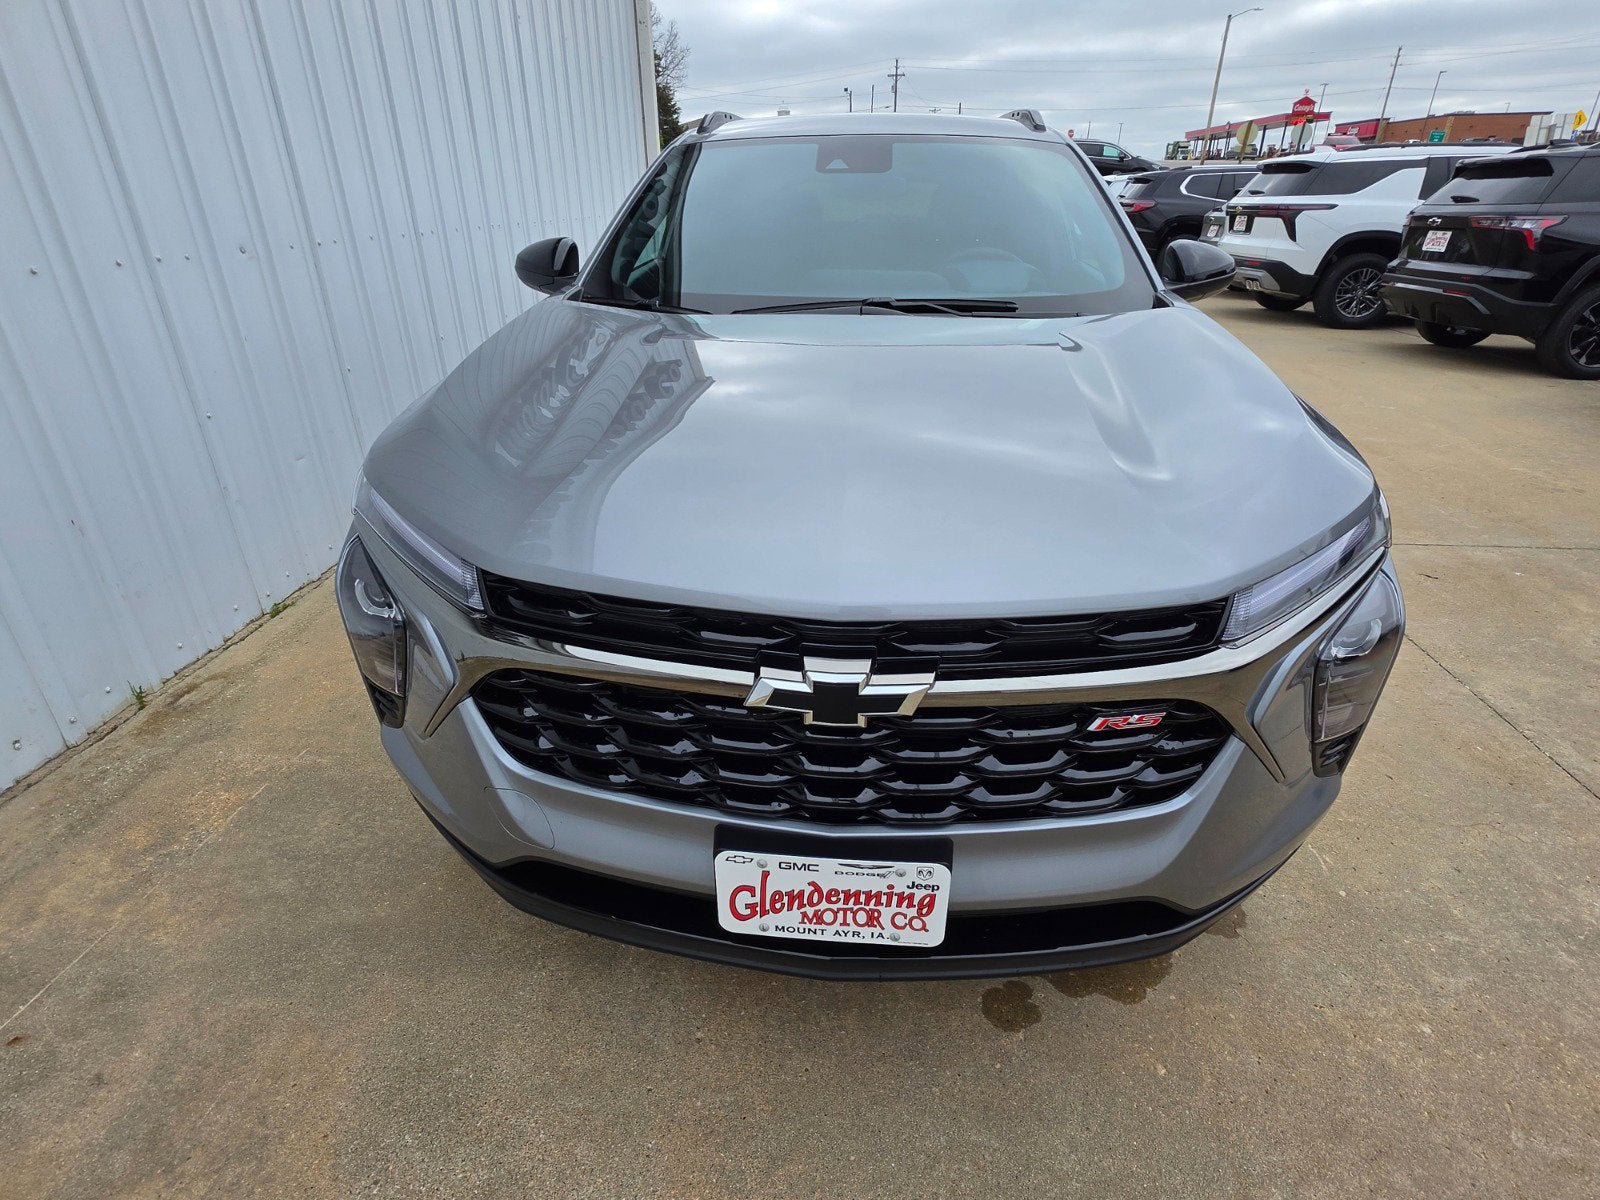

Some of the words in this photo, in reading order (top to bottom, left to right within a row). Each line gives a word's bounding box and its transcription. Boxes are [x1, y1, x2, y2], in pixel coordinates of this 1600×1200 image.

[1086, 712, 1166, 732] RS
[778, 861, 820, 873] GMC
[834, 870, 886, 878] DODGE
[906, 881, 940, 893] Jeep
[729, 870, 937, 921] Glendenning
[798, 907, 885, 931] MOTOR
[774, 925, 827, 936] MOUNT
[832, 929, 865, 940] AYR,
[870, 931, 890, 940] IA.
